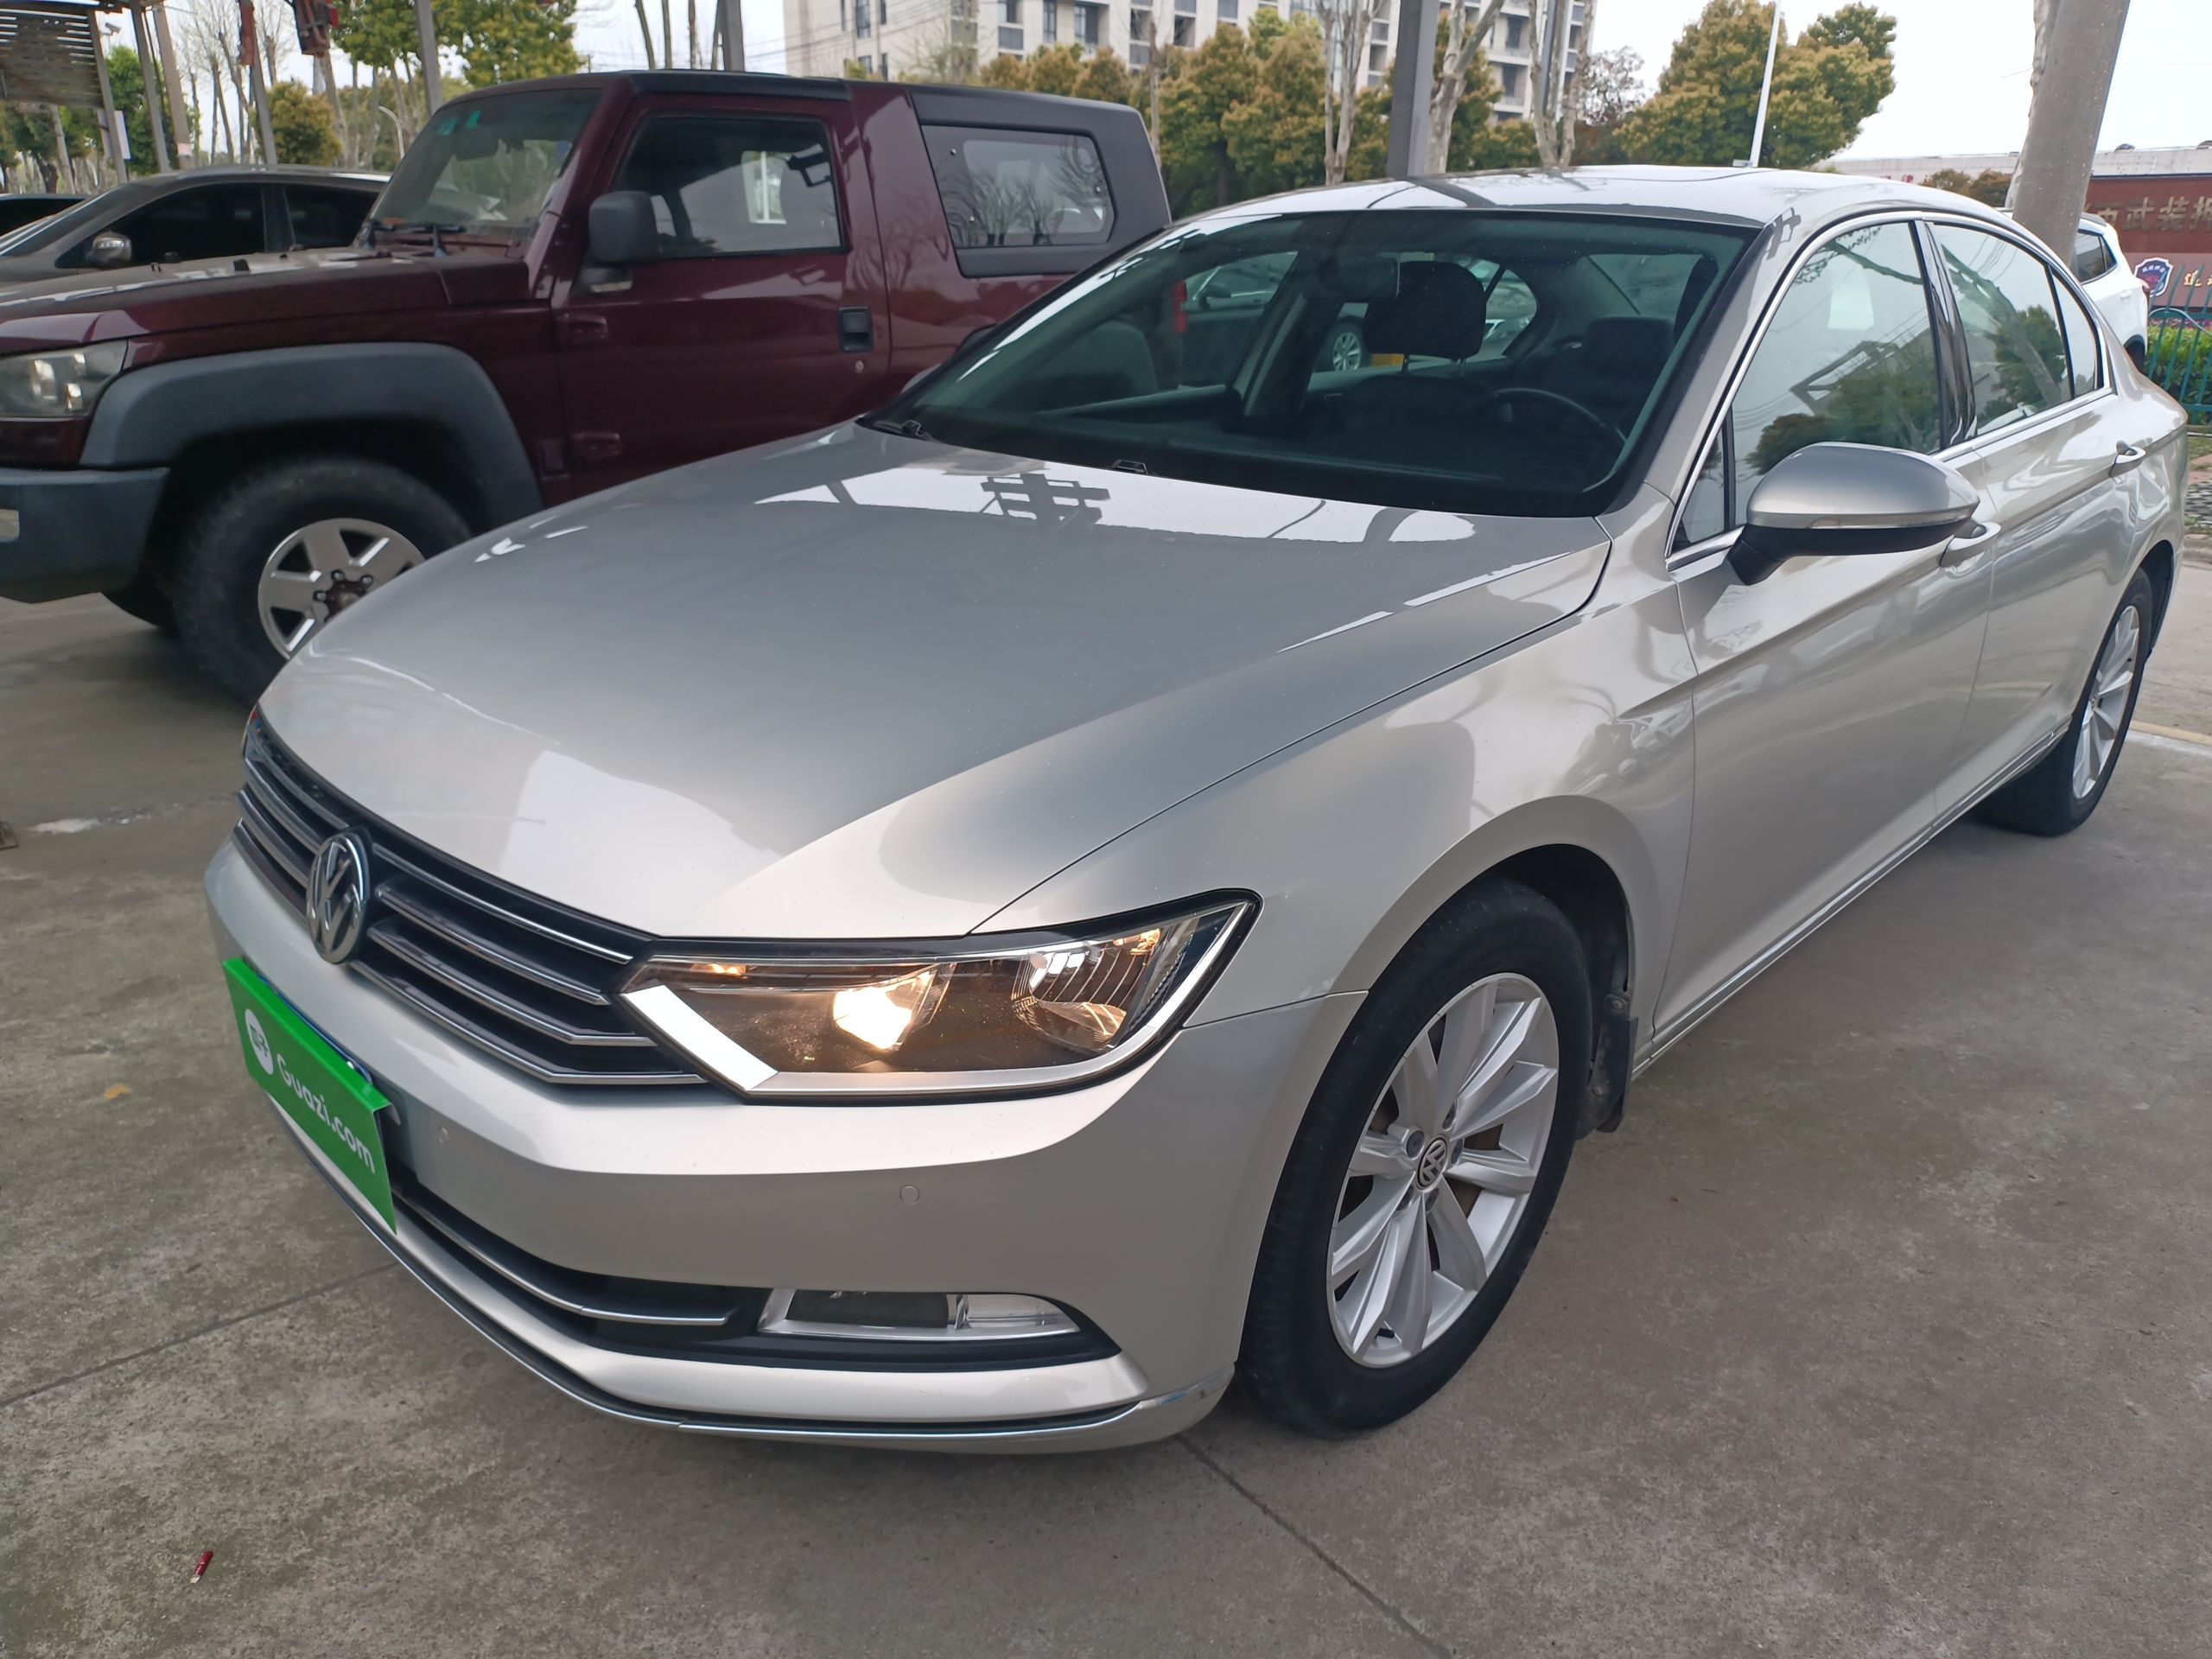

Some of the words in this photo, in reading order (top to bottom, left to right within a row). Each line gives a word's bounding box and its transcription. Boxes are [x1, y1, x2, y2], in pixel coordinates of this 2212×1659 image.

[2084, 195, 2212, 232] 西武装押
[276, 1053, 376, 1175] Guazi.com
